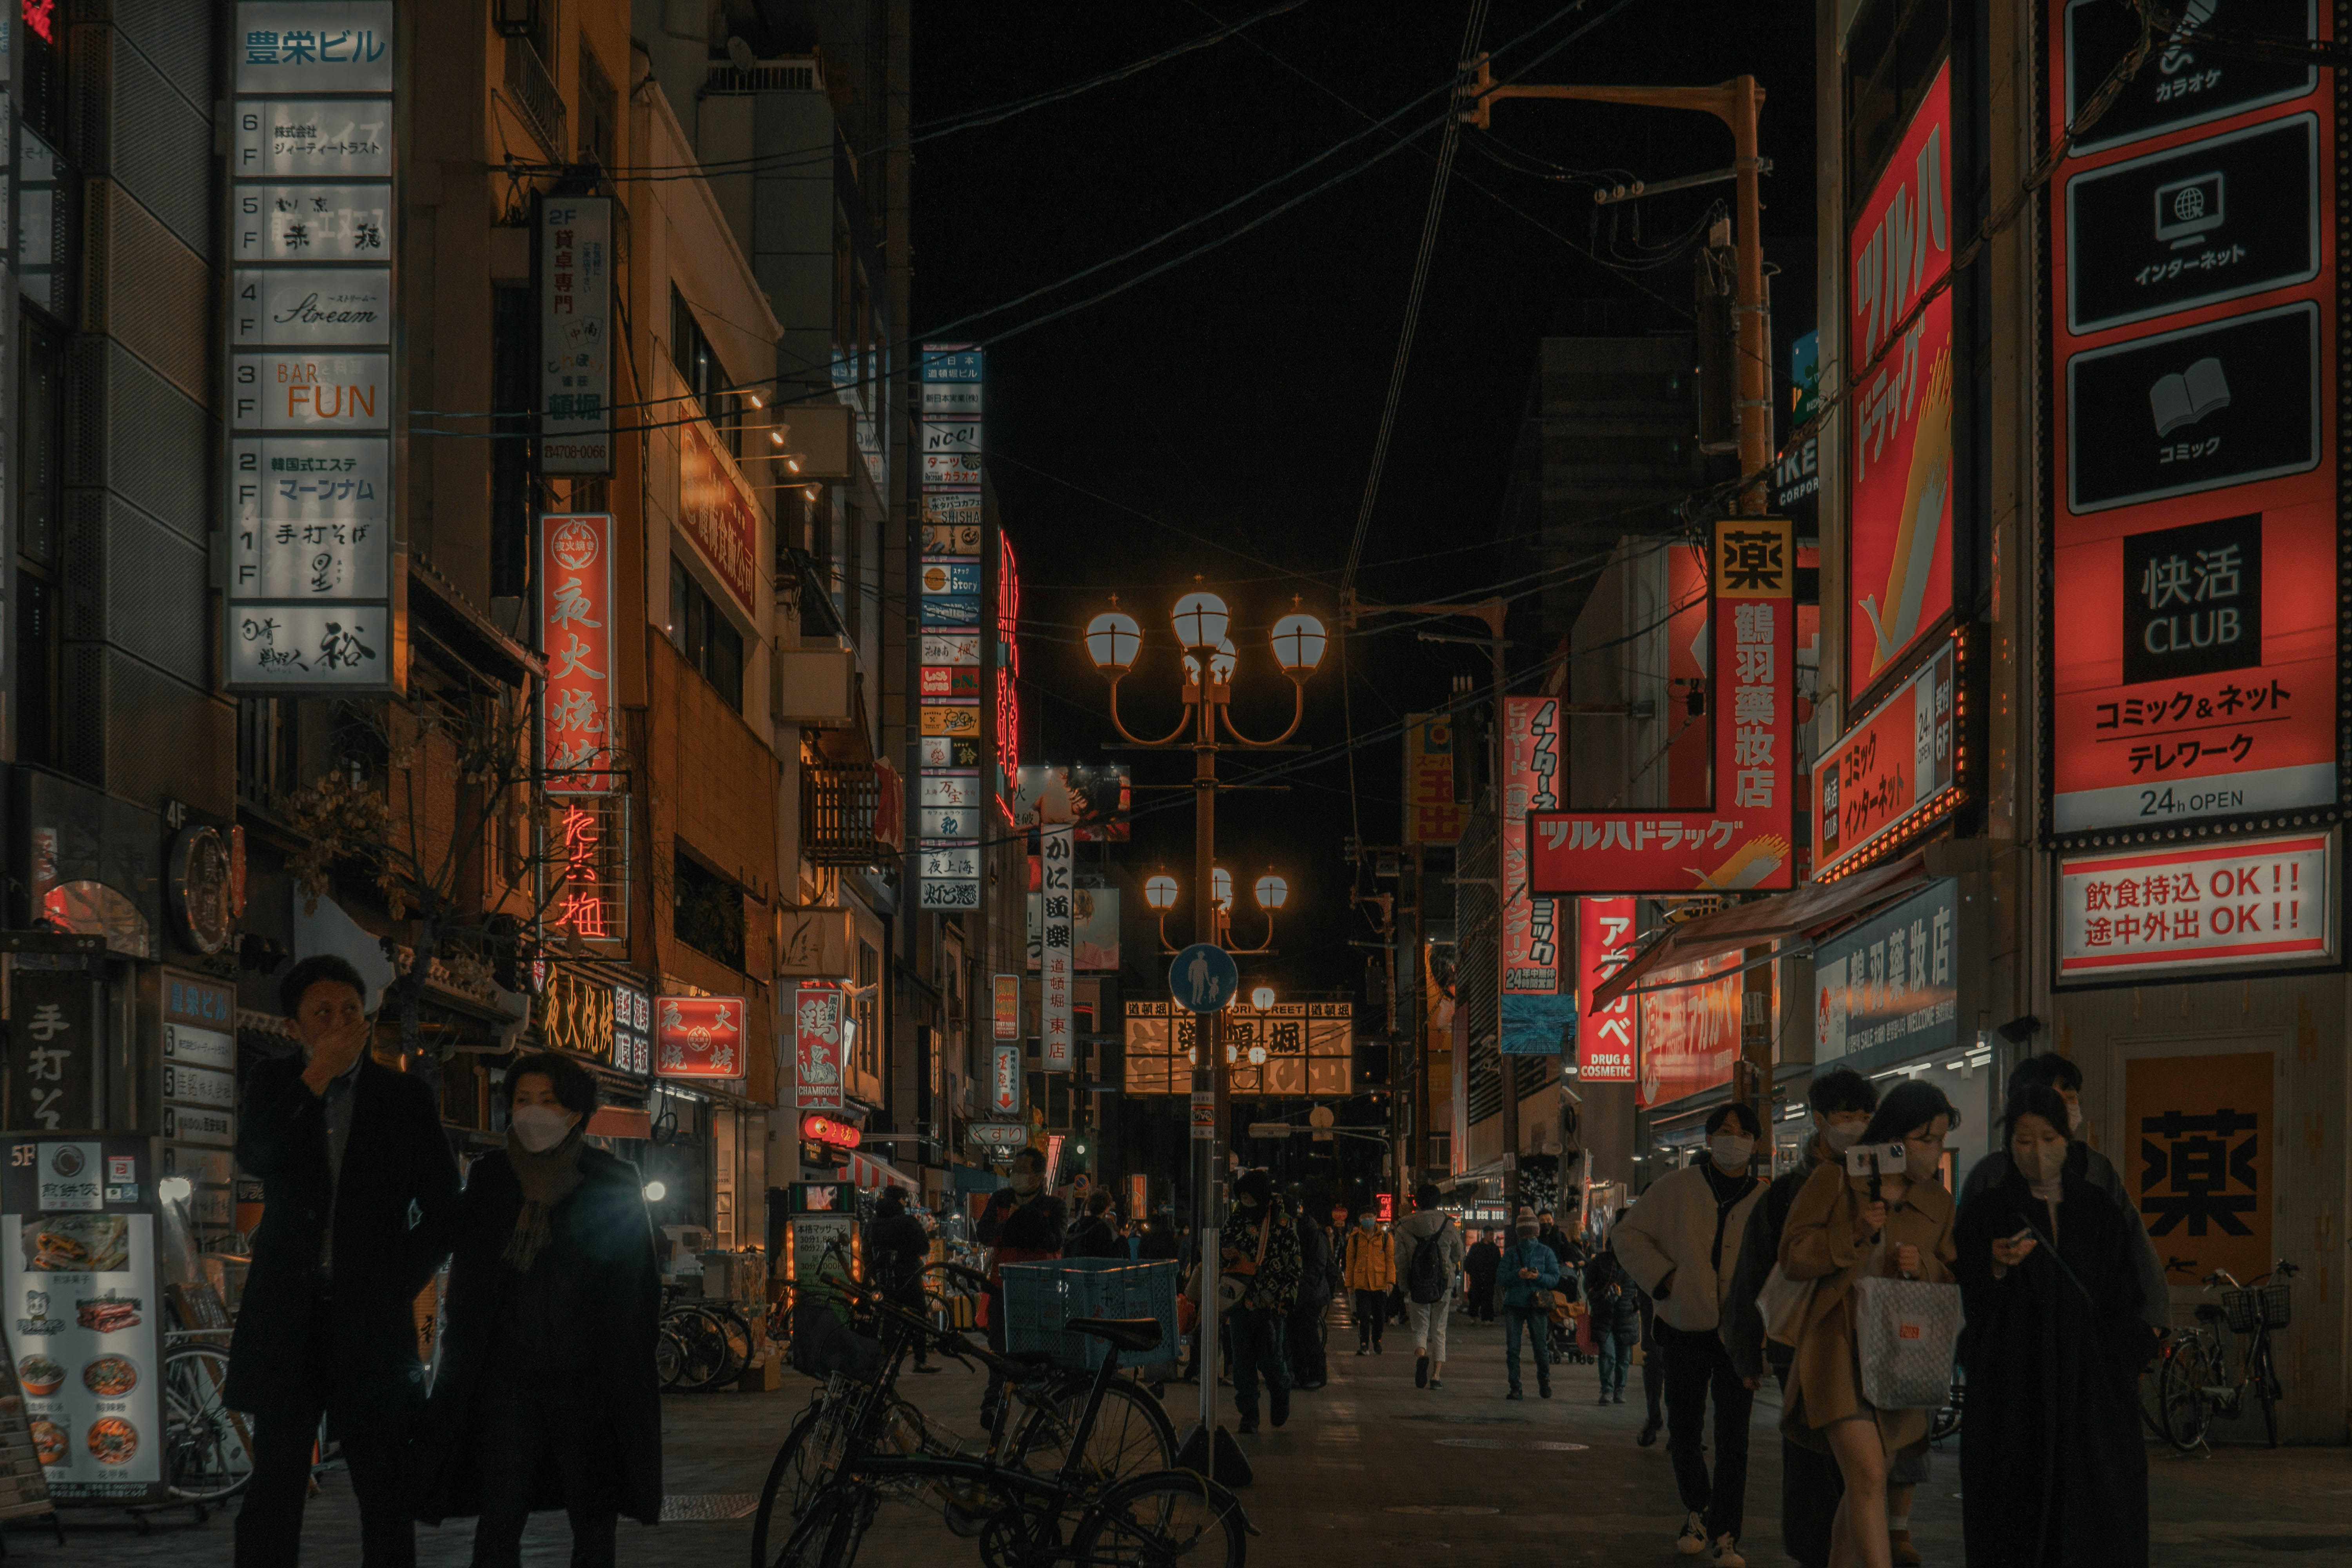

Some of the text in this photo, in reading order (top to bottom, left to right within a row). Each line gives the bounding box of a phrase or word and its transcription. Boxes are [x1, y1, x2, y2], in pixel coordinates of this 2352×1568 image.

[245, 29, 385, 65] 豊栄ビル
[2156, 70, 2221, 103] カラオケ
[274, 125, 317, 138] 株式会社
[550, 210, 577, 225] 2F
[1857, 122, 1946, 367] ツルハ
[554, 229, 573, 314] 貸卓専門
[2135, 243, 2247, 287] インターネット
[274, 293, 377, 323] Stream
[277, 364, 317, 383] BAR
[928, 369, 977, 378] 道頓堀ビル
[288, 385, 374, 418] FUN
[1859, 310, 1926, 483] ドラッグ
[929, 427, 974, 449] NCCI
[2160, 436, 2221, 464] コミック
[271, 458, 357, 472] 韓国式エステ
[928, 457, 959, 468] ダーツ
[944, 472, 978, 482] カラオケ
[279, 479, 374, 500] マーンナム
[942, 511, 981, 524] SHISHA
[275, 524, 370, 545] 手打そば
[1724, 530, 1783, 590] 薬
[953, 577, 978, 592] Story
[2141, 543, 2242, 610] 快活
[2144, 606, 2241, 655] CLUB
[1936, 721, 1950, 761] 6F
[1845, 730, 1877, 788] コミック
[2128, 733, 2254, 775] テレワーク
[1845, 762, 1904, 840] インターネット
[2190, 789, 2243, 811] OPEN
[1539, 820, 1743, 851] ツルハドラッグ
[928, 858, 975, 875] 夜上海
[2084, 873, 2200, 913] 飲食持込
[2210, 866, 2261, 898] OK
[2084, 907, 2200, 948] 途中外出
[2210, 903, 2261, 935] OK
[1505, 968, 1523, 990] 24
[1128, 1003, 1167, 1016] 道頓堀
[1312, 1004, 1349, 1016] 道頓堀
[1591, 1054, 1630, 1065] DRUG &
[1581, 1065, 1631, 1077] COSMETIC
[799, 1085, 839, 1096] CHAMIROCK
[973, 1127, 1022, 1143] くすり
[11, 1144, 36, 1167] 5F
[2141, 1108, 2258, 1237] 薬
